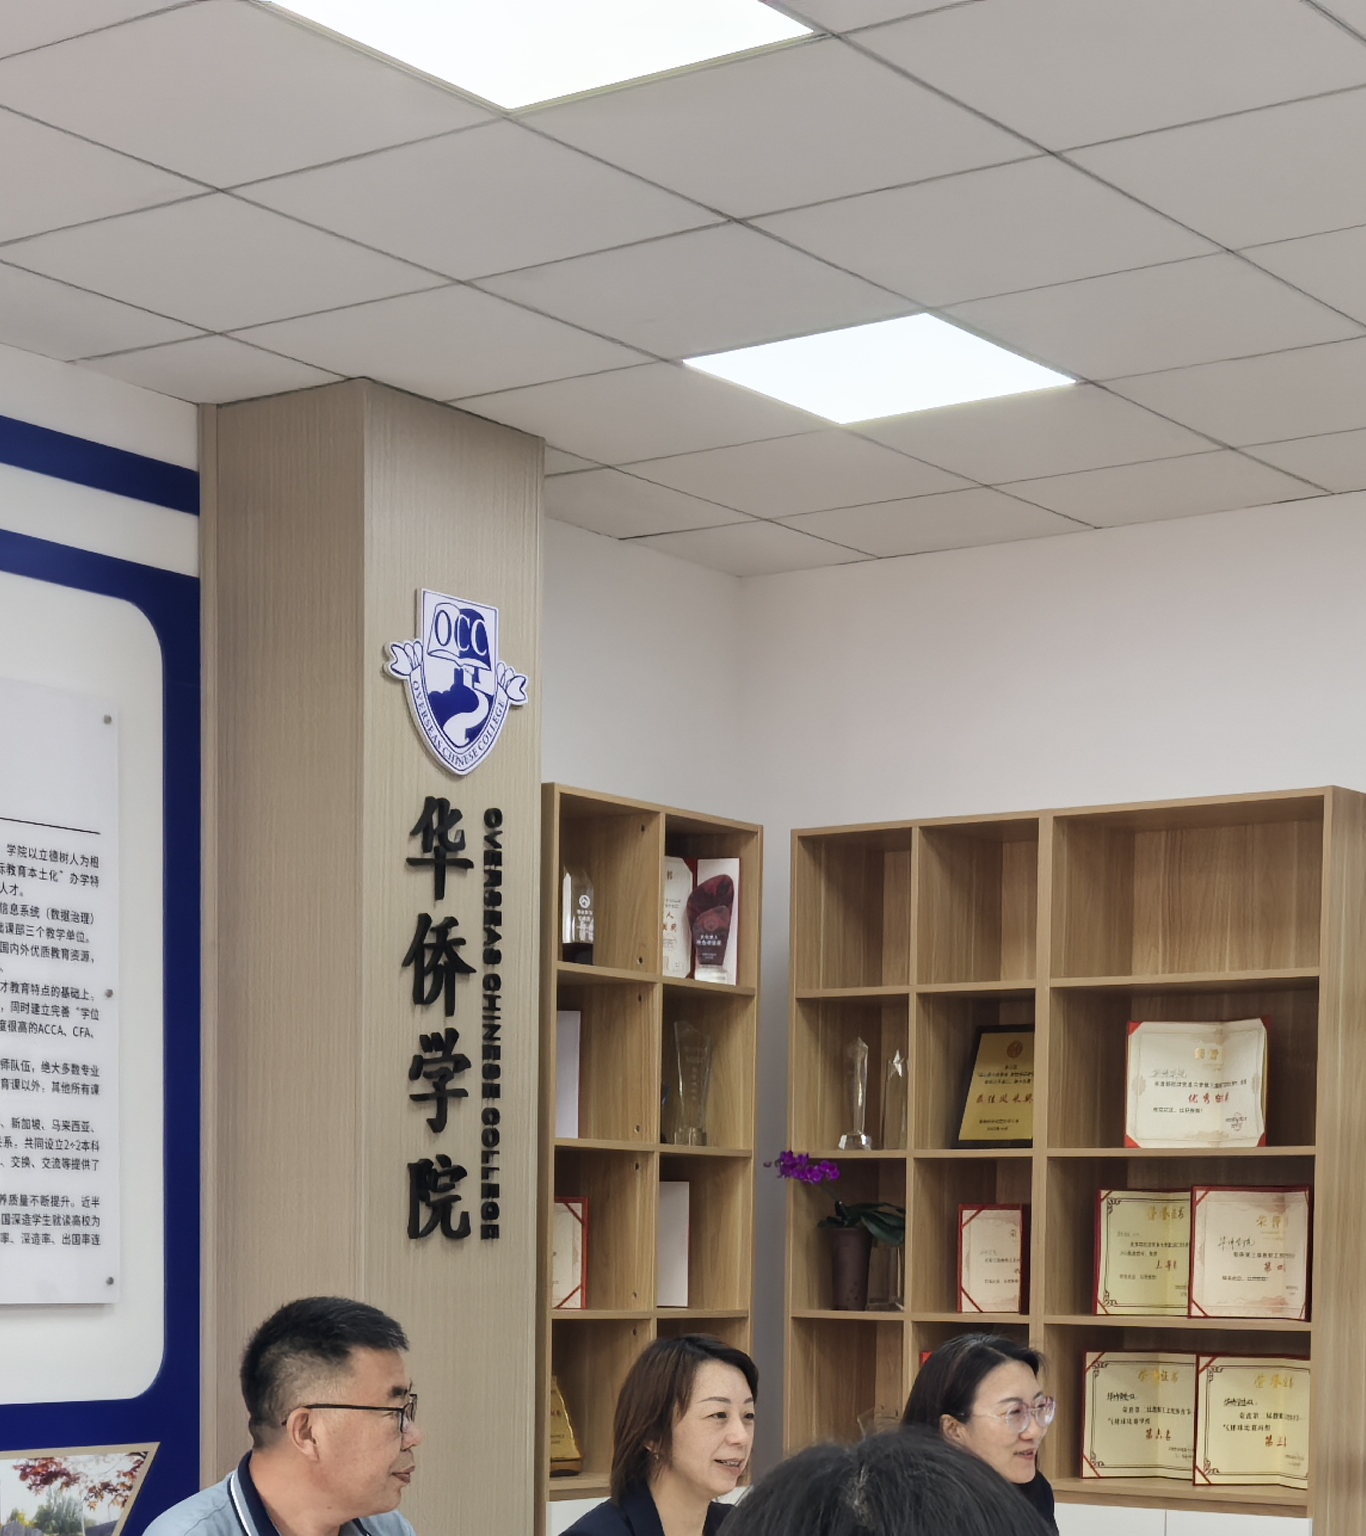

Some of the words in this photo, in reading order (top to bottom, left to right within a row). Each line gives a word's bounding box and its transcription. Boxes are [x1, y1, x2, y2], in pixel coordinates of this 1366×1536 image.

[434, 608, 489, 657] OCC
[412, 679, 442, 751] OVERSEAS
[441, 745, 479, 768] CHINESE
[477, 700, 506, 750] COLLEGE
[482, 807, 503, 965] OVERSEAS
[401, 796, 477, 1239] 华侨学院
[481, 973, 502, 1099] CHINESE
[480, 1107, 501, 1241] COLLEGE
